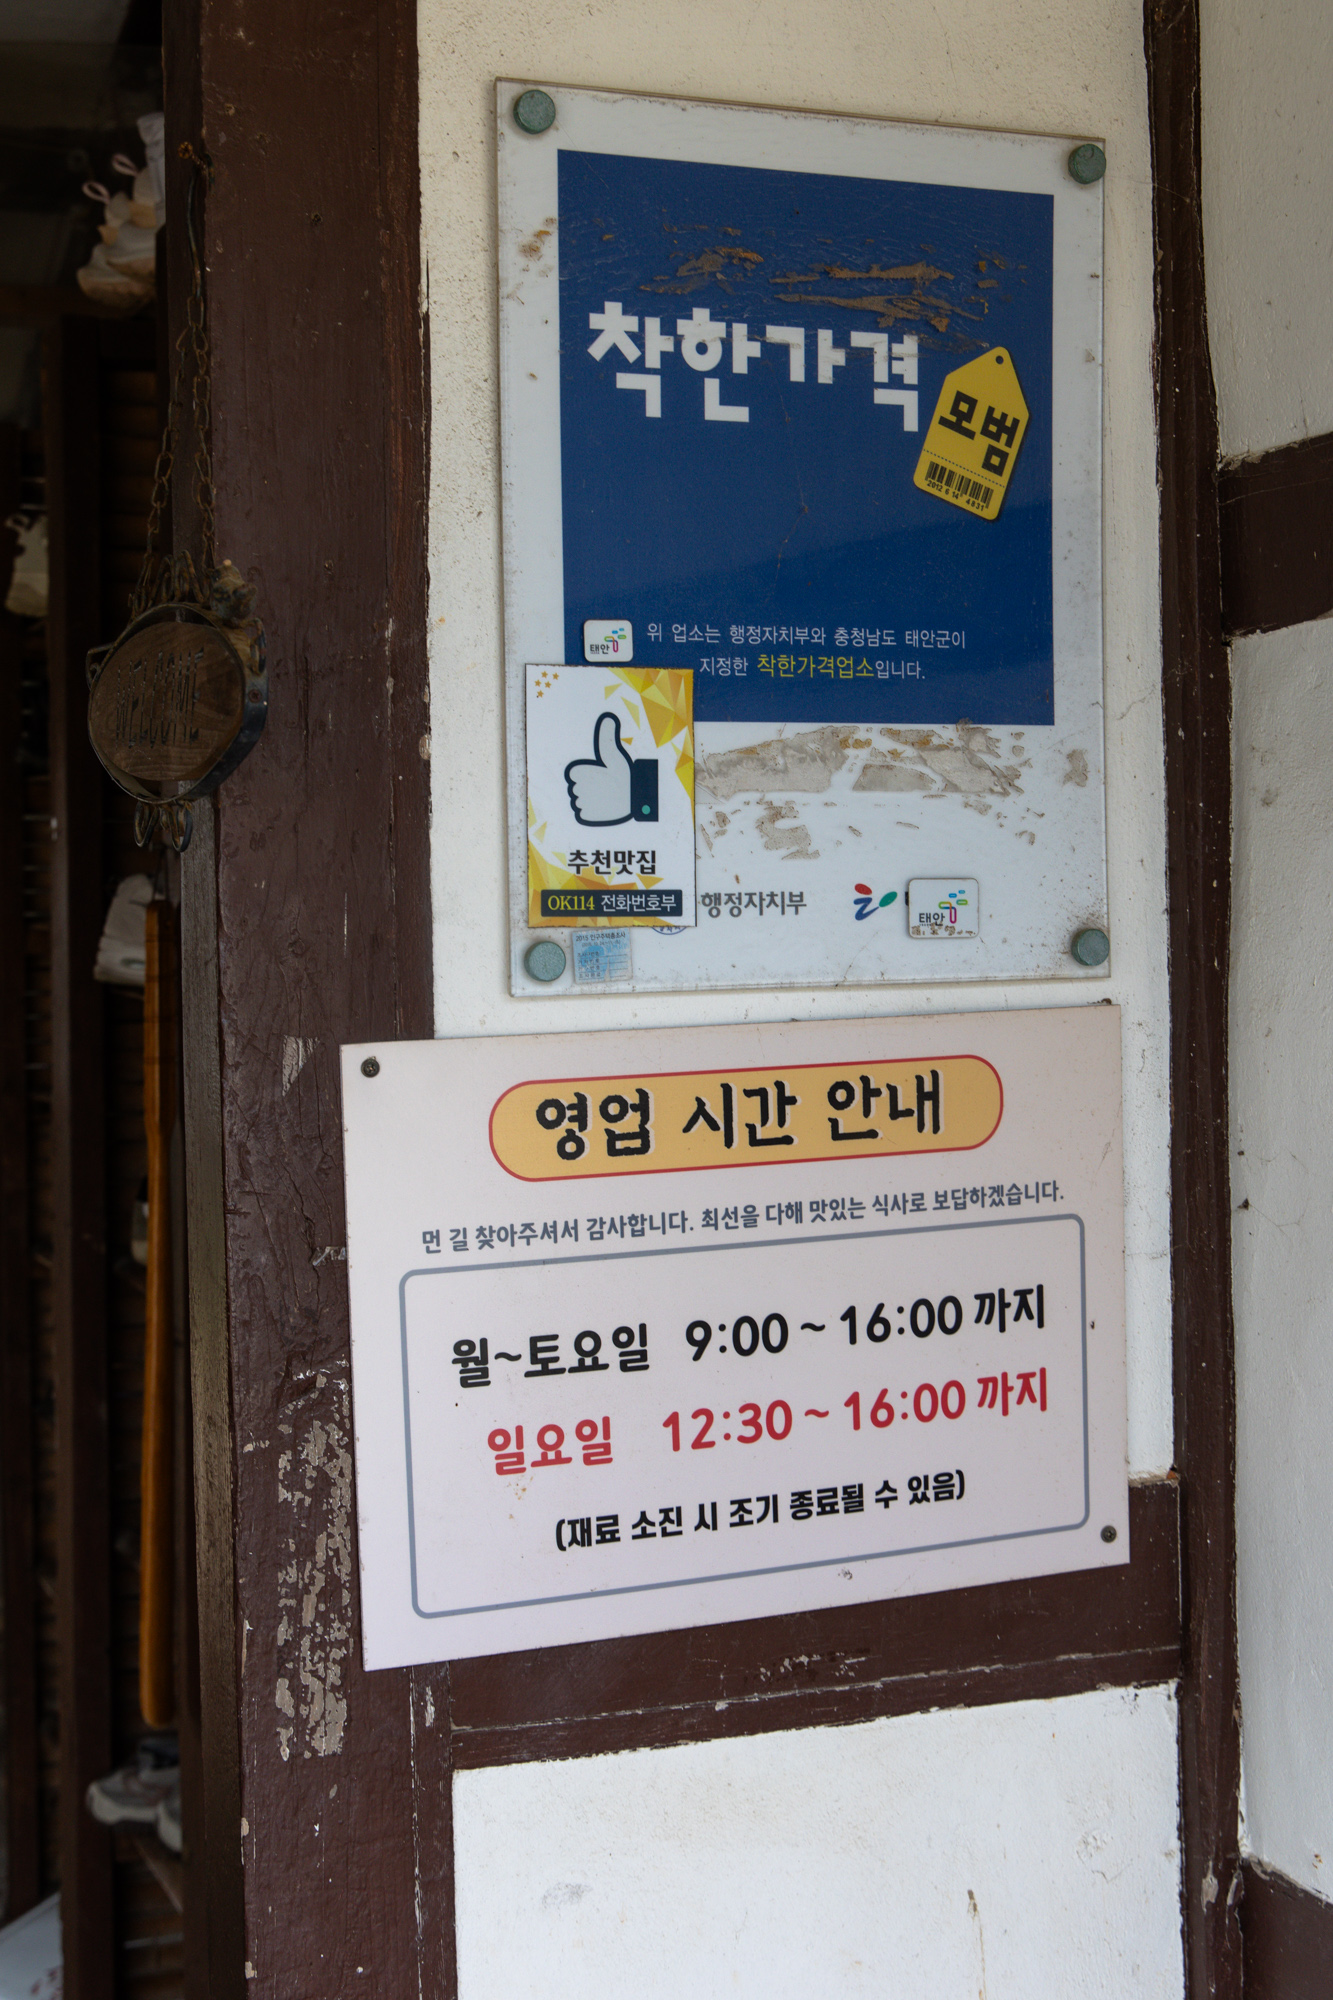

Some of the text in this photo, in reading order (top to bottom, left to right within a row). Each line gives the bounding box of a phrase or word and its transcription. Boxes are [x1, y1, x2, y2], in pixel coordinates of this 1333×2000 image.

[587, 301, 918, 432] 착한가격
[938, 390, 1021, 477] 모범
[927, 480, 943, 492] 2012
[590, 644, 609, 654] 태안
[647, 623, 964, 648] 위 업소는 행정자치부와 충청남도 태안군이
[700, 657, 748, 676] 지정한
[567, 849, 656, 875] 추천맛집
[548, 894, 676, 912] OK114 전화번호부
[701, 891, 806, 918] 행정자치부
[919, 912, 945, 926] 태안
[536, 1069, 942, 1160] 영업 시간 안내
[422, 1180, 1064, 1254] 먼 길 찾아주셔서 감사합니다. 최선을 다해 맛있는 식사로 보답하겠습니다.
[452, 1323, 649, 1388] 월~토요일
[974, 1284, 1044, 1333] 까지
[488, 1416, 613, 1475] 일요일
[977, 1367, 1047, 1416] 까지
[556, 1470, 965, 1551] (재료 소진 시 조기 종료될 수 있음)
